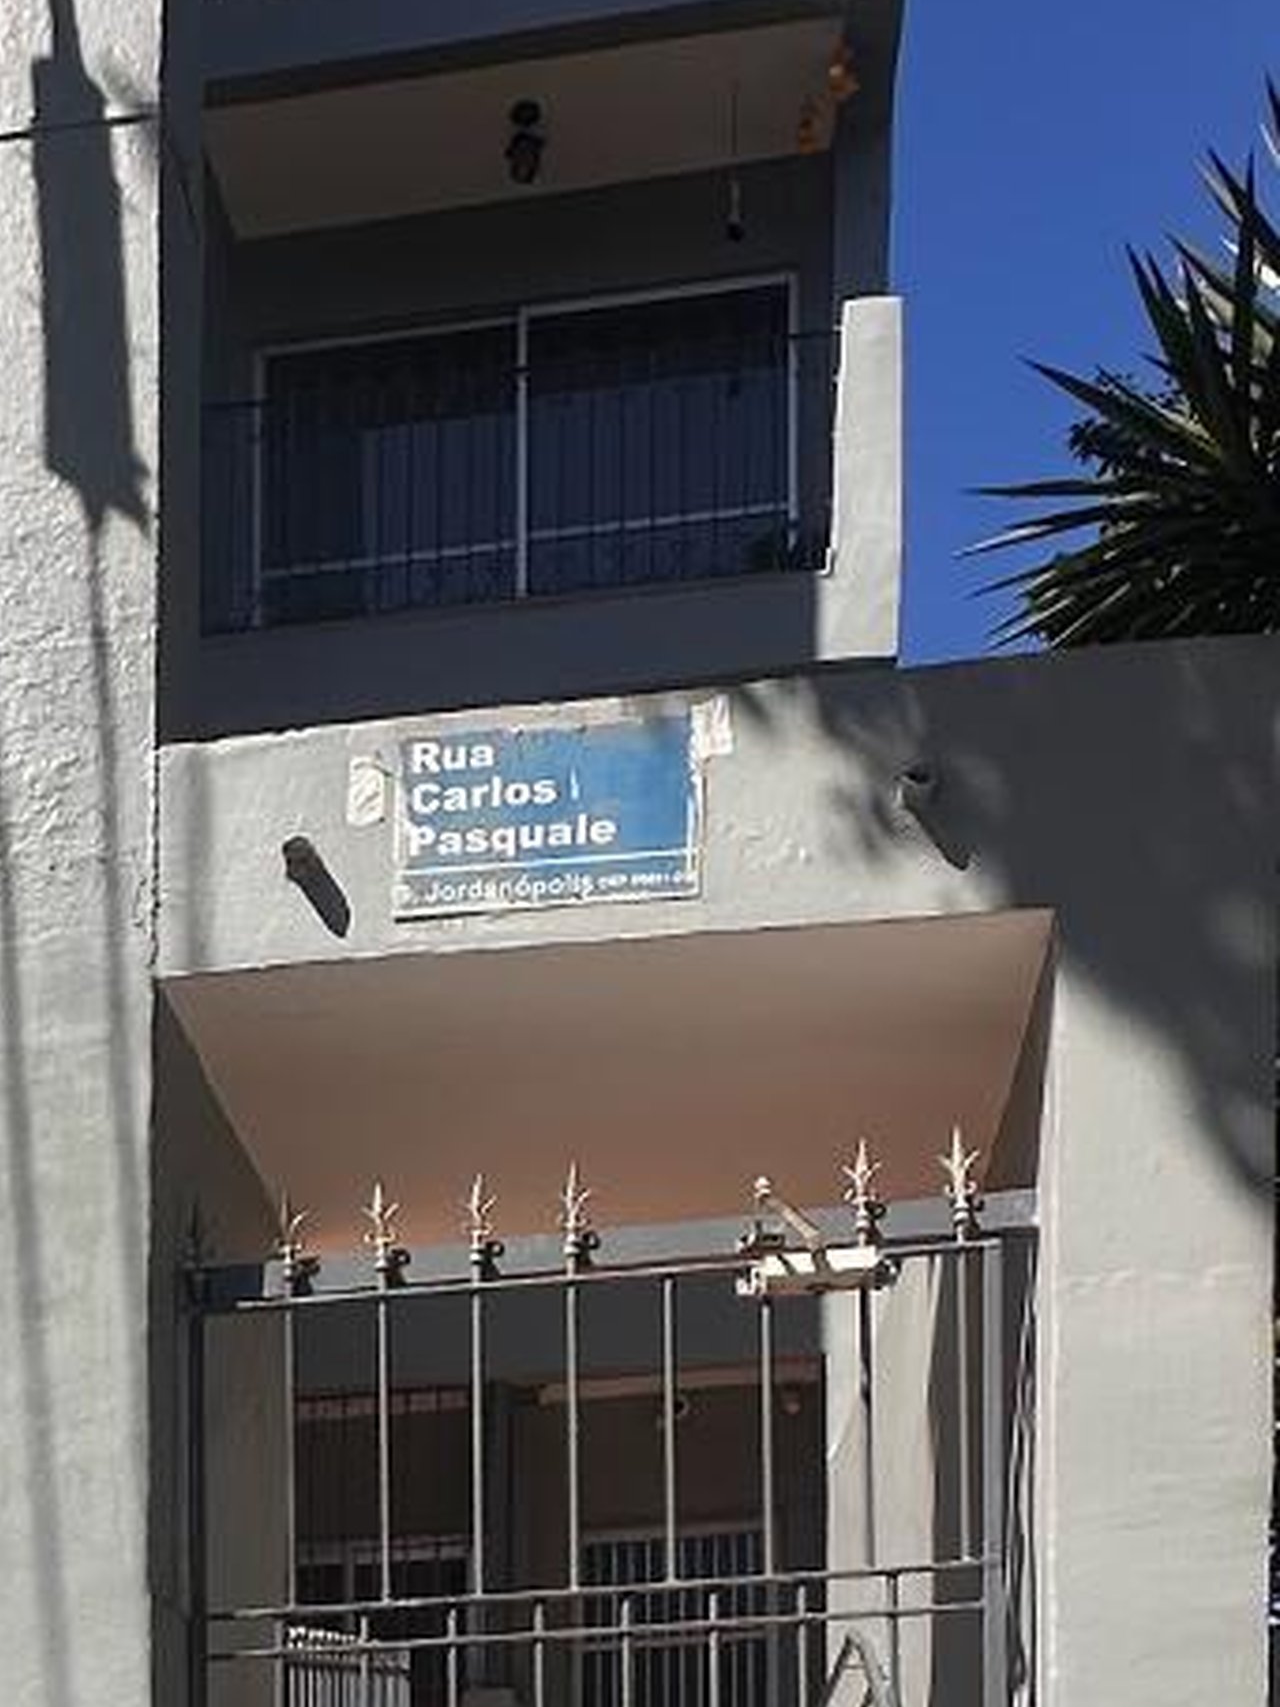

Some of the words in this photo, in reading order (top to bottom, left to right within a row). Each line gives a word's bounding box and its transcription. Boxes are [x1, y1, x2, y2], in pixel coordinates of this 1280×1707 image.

[412, 741, 495, 774] Rua
[412, 775, 559, 814] Carlos
[408, 813, 617, 857] Pasquale
